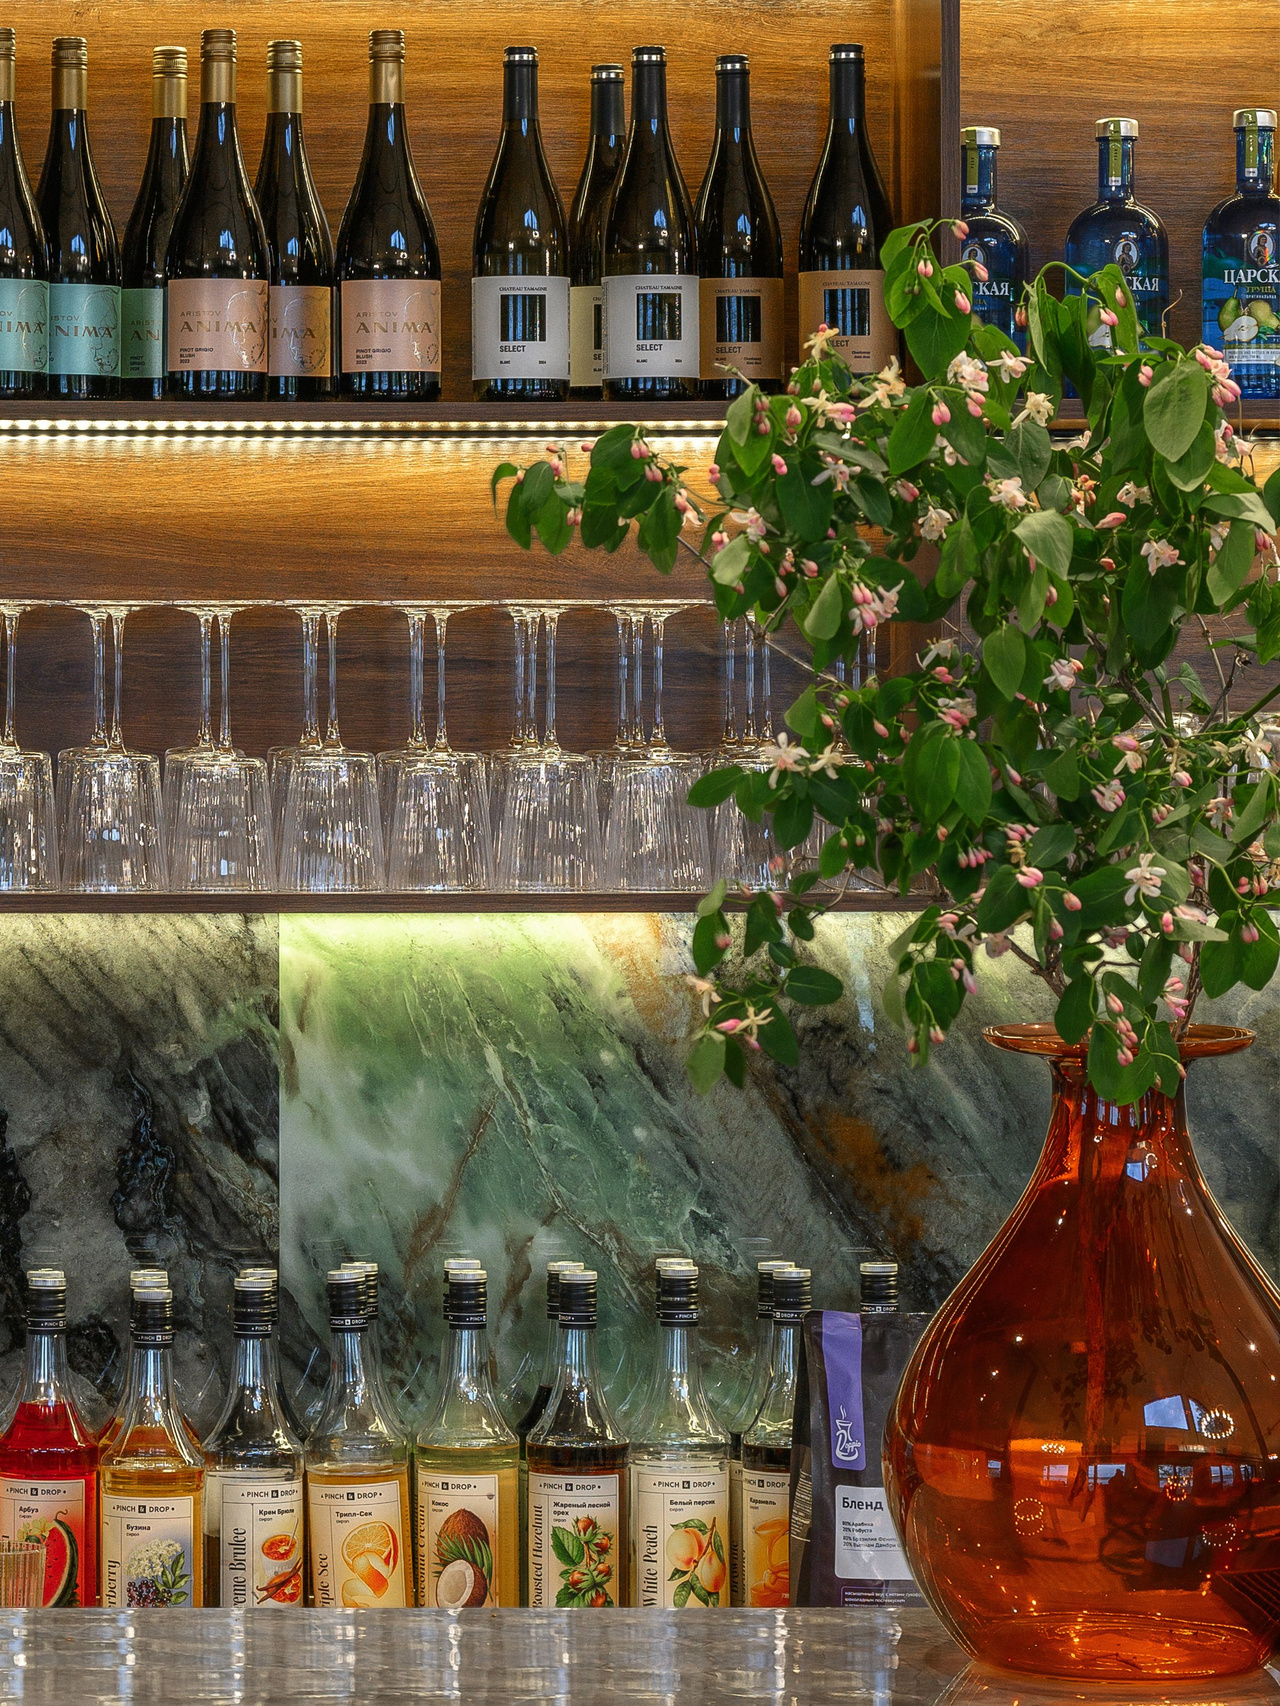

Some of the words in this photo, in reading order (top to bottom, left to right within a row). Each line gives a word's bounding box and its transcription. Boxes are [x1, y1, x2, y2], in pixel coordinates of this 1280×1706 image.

[1126, 277, 1159, 291] СКАЯ
[1224, 269, 1280, 285] ЦАРСК
[973, 282, 1009, 295] СКАЯ
[180, 321, 258, 333] ANIMA
[272, 328, 316, 339] IMA
[356, 322, 432, 333] ANIMA
[424, 1481, 440, 1489] PINCH
[116, 1505, 136, 1513] PINCH
[750, 1497, 776, 1506] Карамель
[842, 1497, 883, 1511] Бленд
[19, 1506, 38, 1514] Арбуз
[532, 1504, 543, 1558] Hazelnut
[229, 1528, 246, 1573] Brulee
[642, 1525, 658, 1564] Peach
[318, 1553, 328, 1577] Sec
[107, 1560, 120, 1607] rberry
[533, 1562, 543, 1607] Roasted
[643, 1567, 658, 1607] White
[233, 1576, 246, 1607] reme
[318, 1581, 334, 1607] riple
